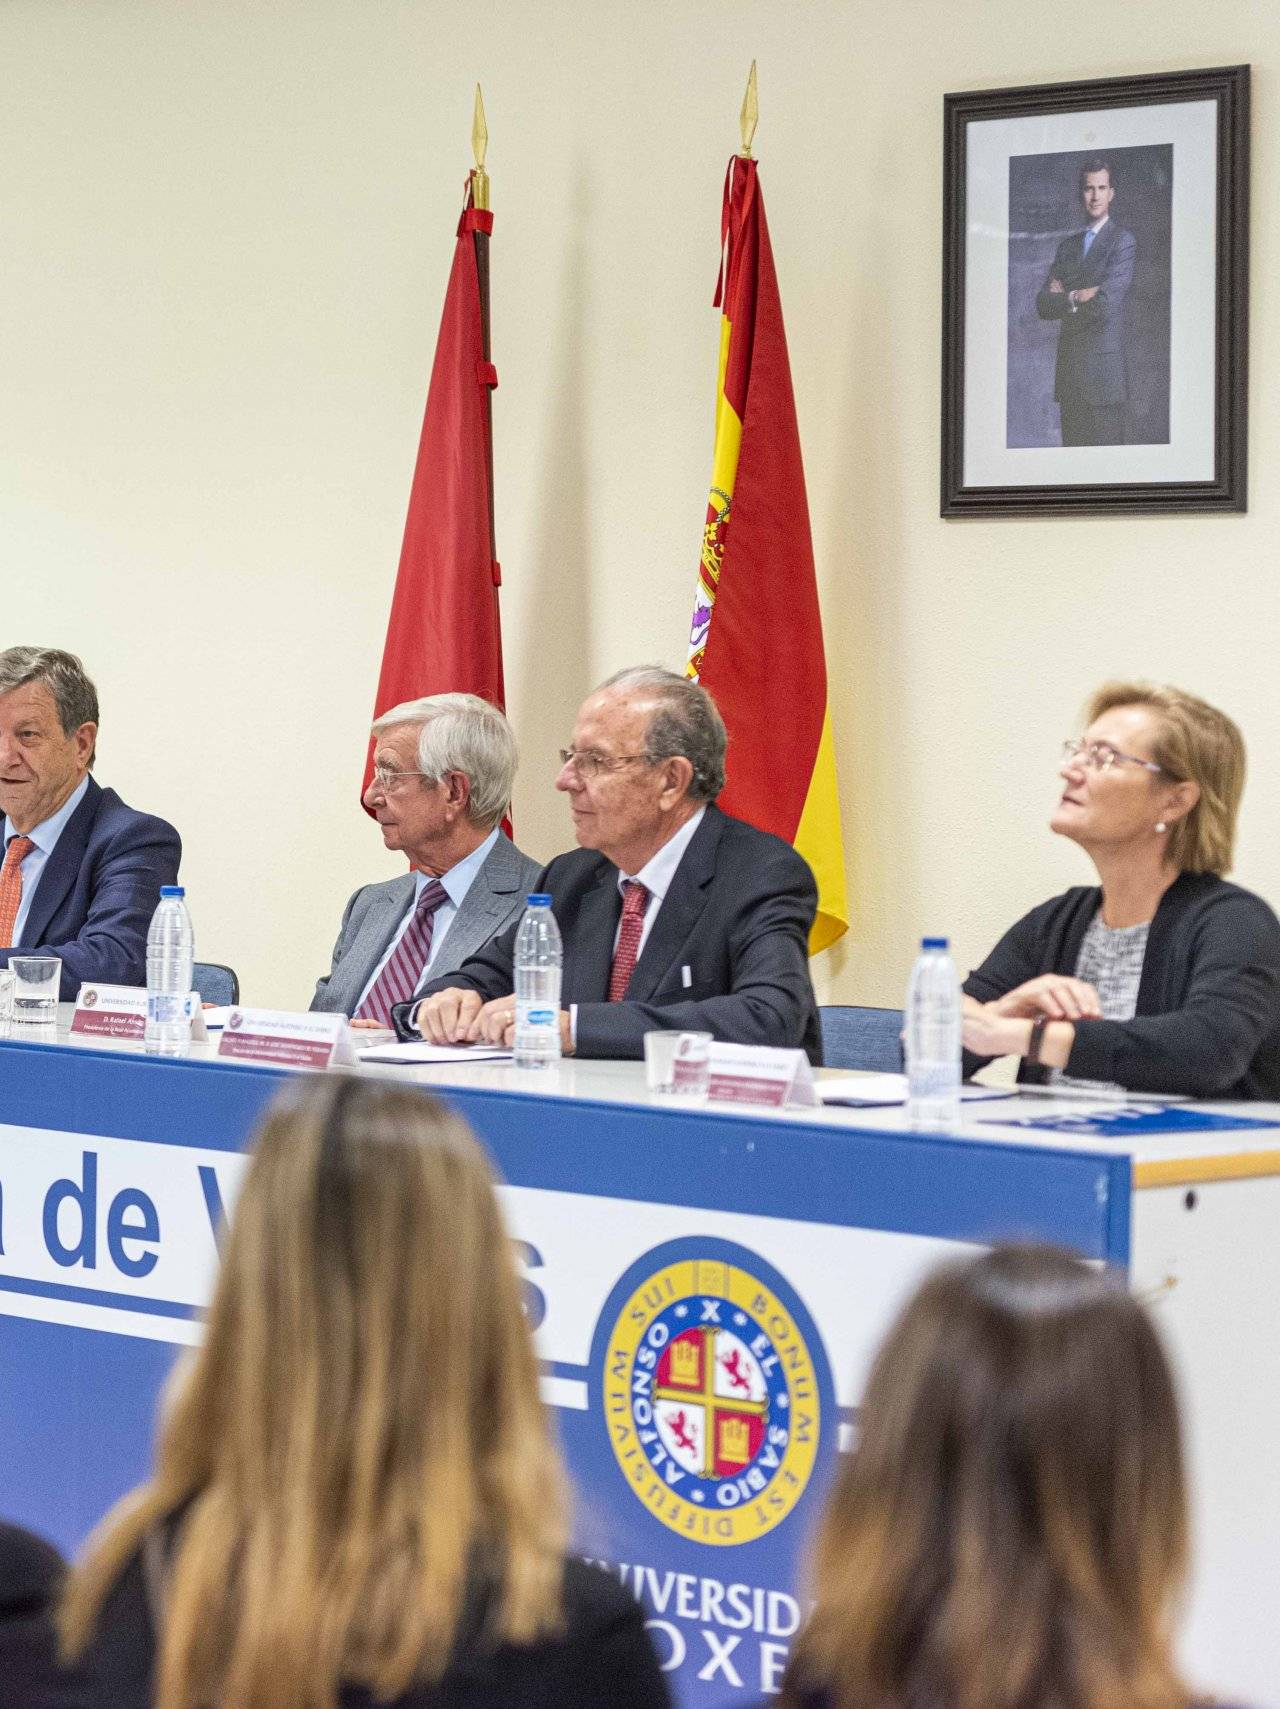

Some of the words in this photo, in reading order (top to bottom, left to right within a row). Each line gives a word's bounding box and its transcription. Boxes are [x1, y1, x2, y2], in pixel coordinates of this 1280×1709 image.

[42, 1151, 160, 1278] de
[700, 1299, 721, 1323] X
[630, 1277, 677, 1327] SUI
[751, 1293, 812, 1443] BONUM
[750, 1333, 779, 1378] EL
[631, 1322, 686, 1486] ALFONSO
[716, 1424, 790, 1507] SABIO
[696, 1629, 745, 1688] X
